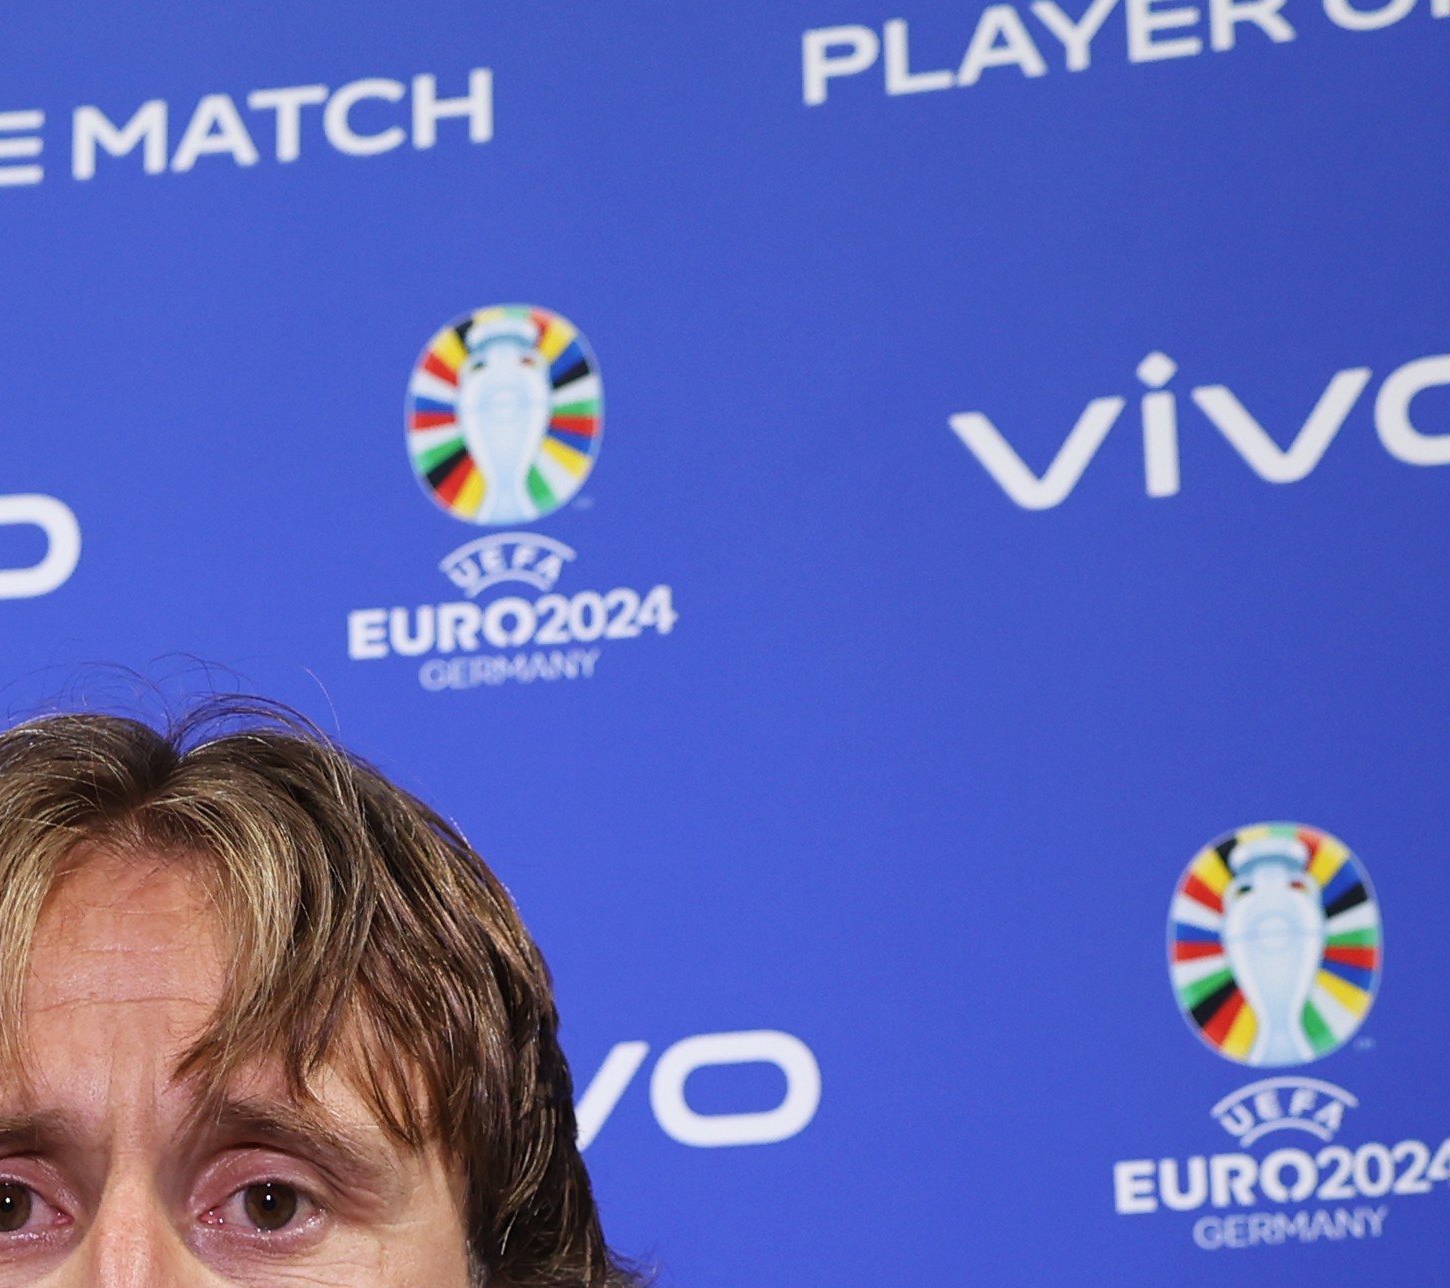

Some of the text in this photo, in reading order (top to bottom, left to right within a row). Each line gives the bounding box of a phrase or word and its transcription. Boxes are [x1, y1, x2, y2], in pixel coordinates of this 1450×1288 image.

[801, 0, 1296, 106] PLAYER
[71, 67, 494, 181] MATCH
[448, 543, 563, 590] UEFA
[418, 648, 600, 691] GERMANY
[1220, 1087, 1344, 1136] UEFA
[1193, 1204, 1387, 1250] GERMANY
